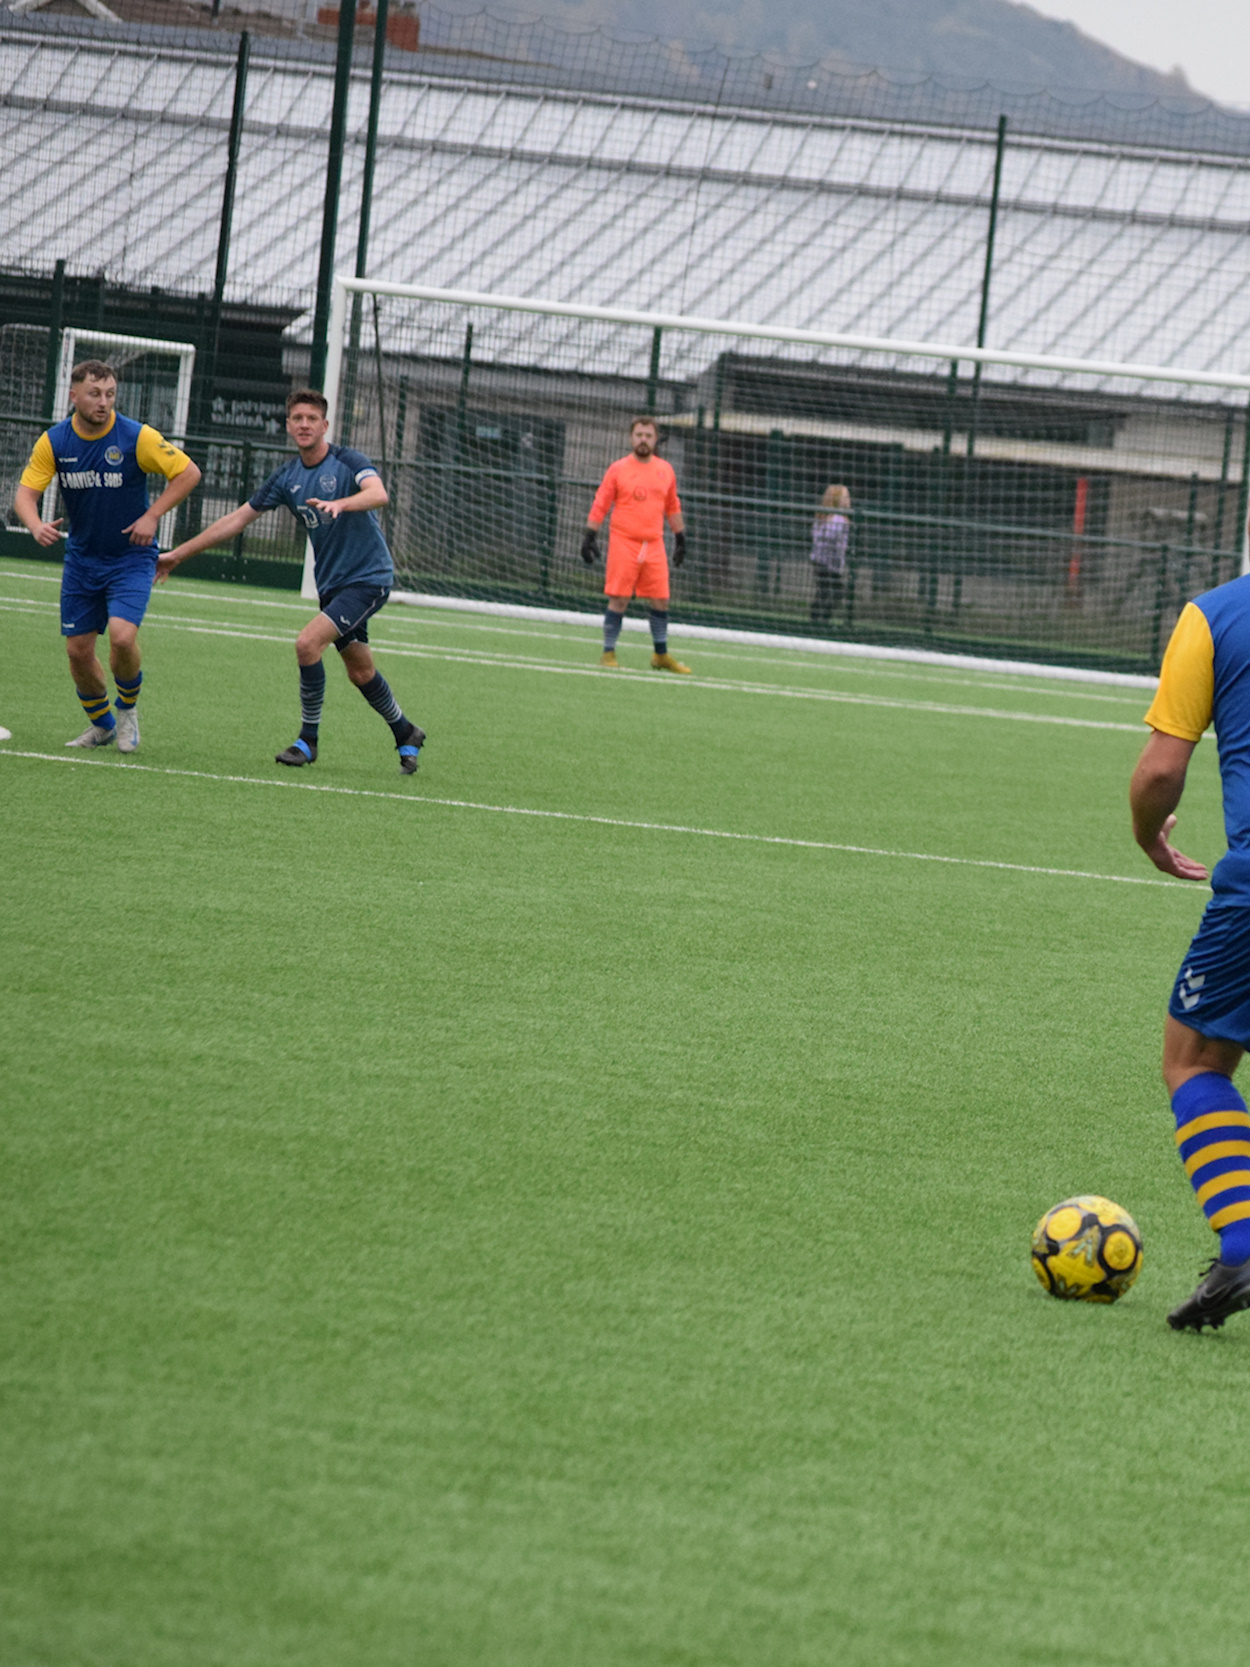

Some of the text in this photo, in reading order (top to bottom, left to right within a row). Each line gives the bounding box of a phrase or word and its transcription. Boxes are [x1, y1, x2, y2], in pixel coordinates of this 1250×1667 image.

[60, 470, 123, 489] S DAVIES & SONS
